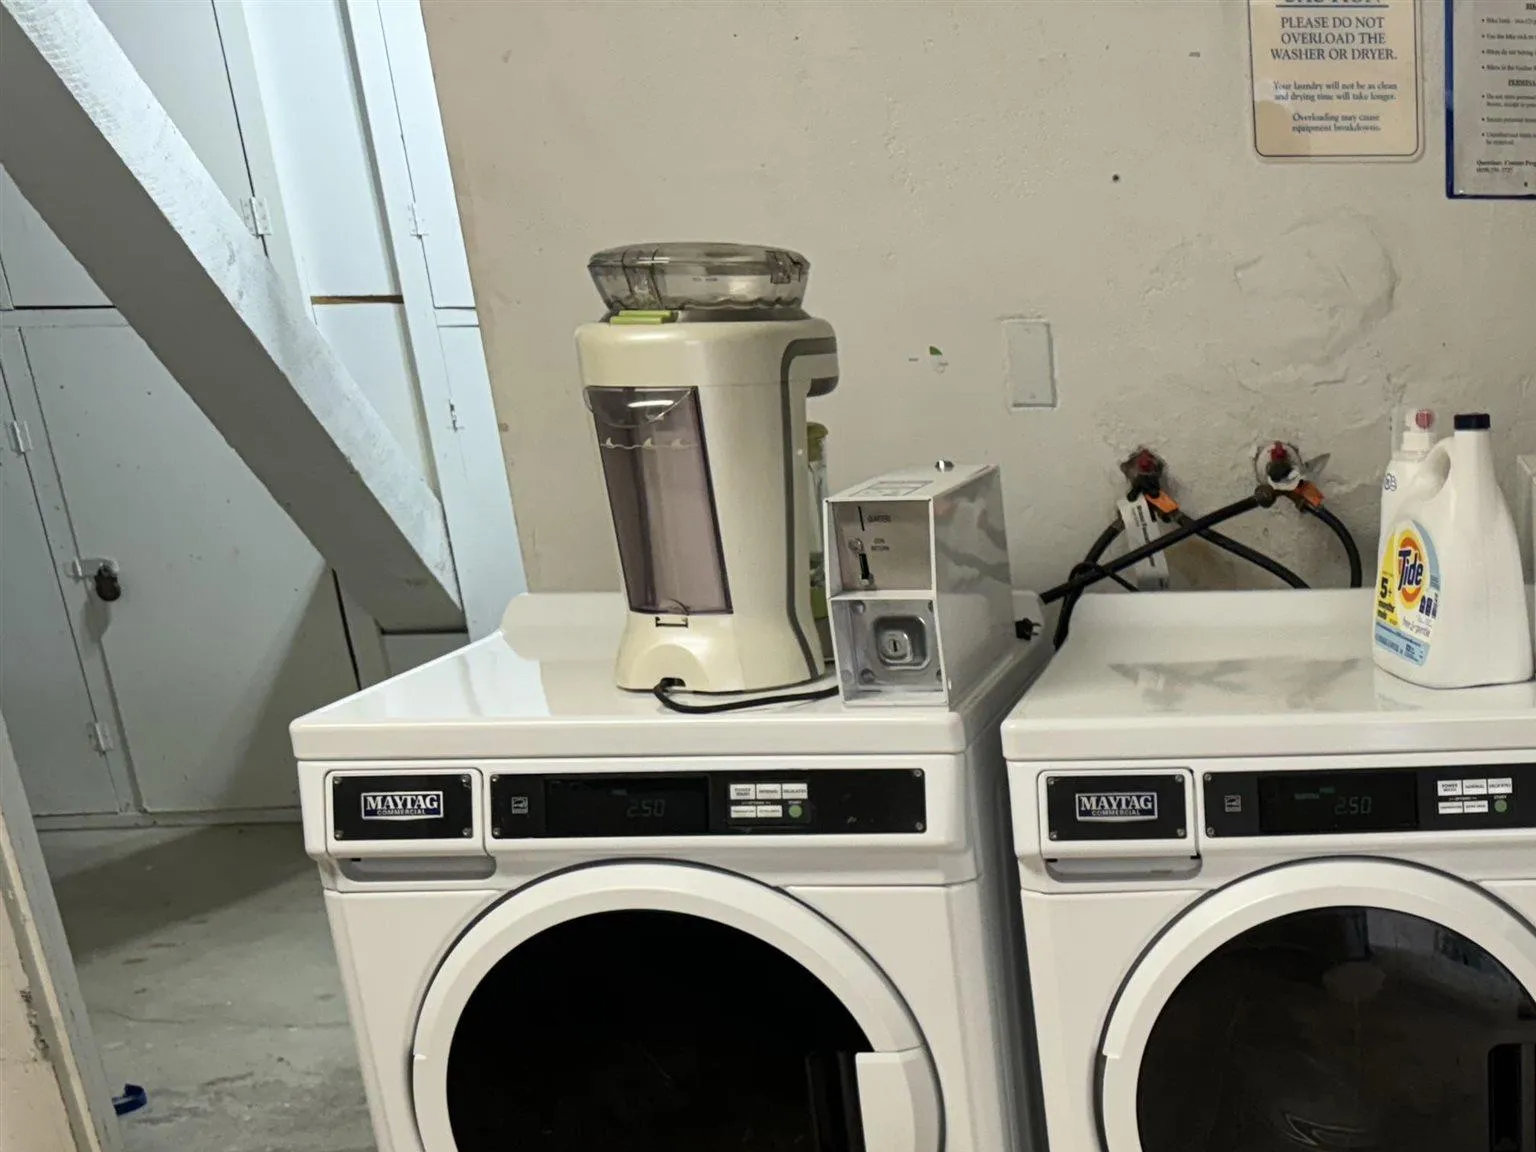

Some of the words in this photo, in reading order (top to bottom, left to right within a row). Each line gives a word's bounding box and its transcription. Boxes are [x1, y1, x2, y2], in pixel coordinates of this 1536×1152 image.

[1281, 16, 1329, 28] PLEASE
[1333, 16, 1352, 28] DO
[1356, 16, 1385, 28] NOT
[1281, 32, 1355, 44] OVERLOAD
[1358, 32, 1386, 44] THE
[1271, 48, 1325, 60] WASHER
[1328, 48, 1348, 60] OR
[1351, 48, 1398, 60] DRYER.
[1274, 81, 1291, 90] Your
[1293, 81, 1323, 91] laundry
[1325, 81, 1340, 90] will
[1342, 82, 1354, 90] not
[1356, 81, 1366, 90] be
[1378, 81, 1398, 90] clean
[1274, 92, 1289, 101] and
[1290, 92, 1316, 102] drying
[1317, 93, 1333, 101] time
[1336, 91, 1350, 101] will
[1352, 92, 1369, 101] take
[1370, 92, 1397, 103] longer.
[1398, 549, 1424, 591] Tide
[366, 795, 438, 810] MAYTAG
[1080, 796, 1153, 810] MAYTAG
[376, 808, 426, 816] COMMERCIAL
